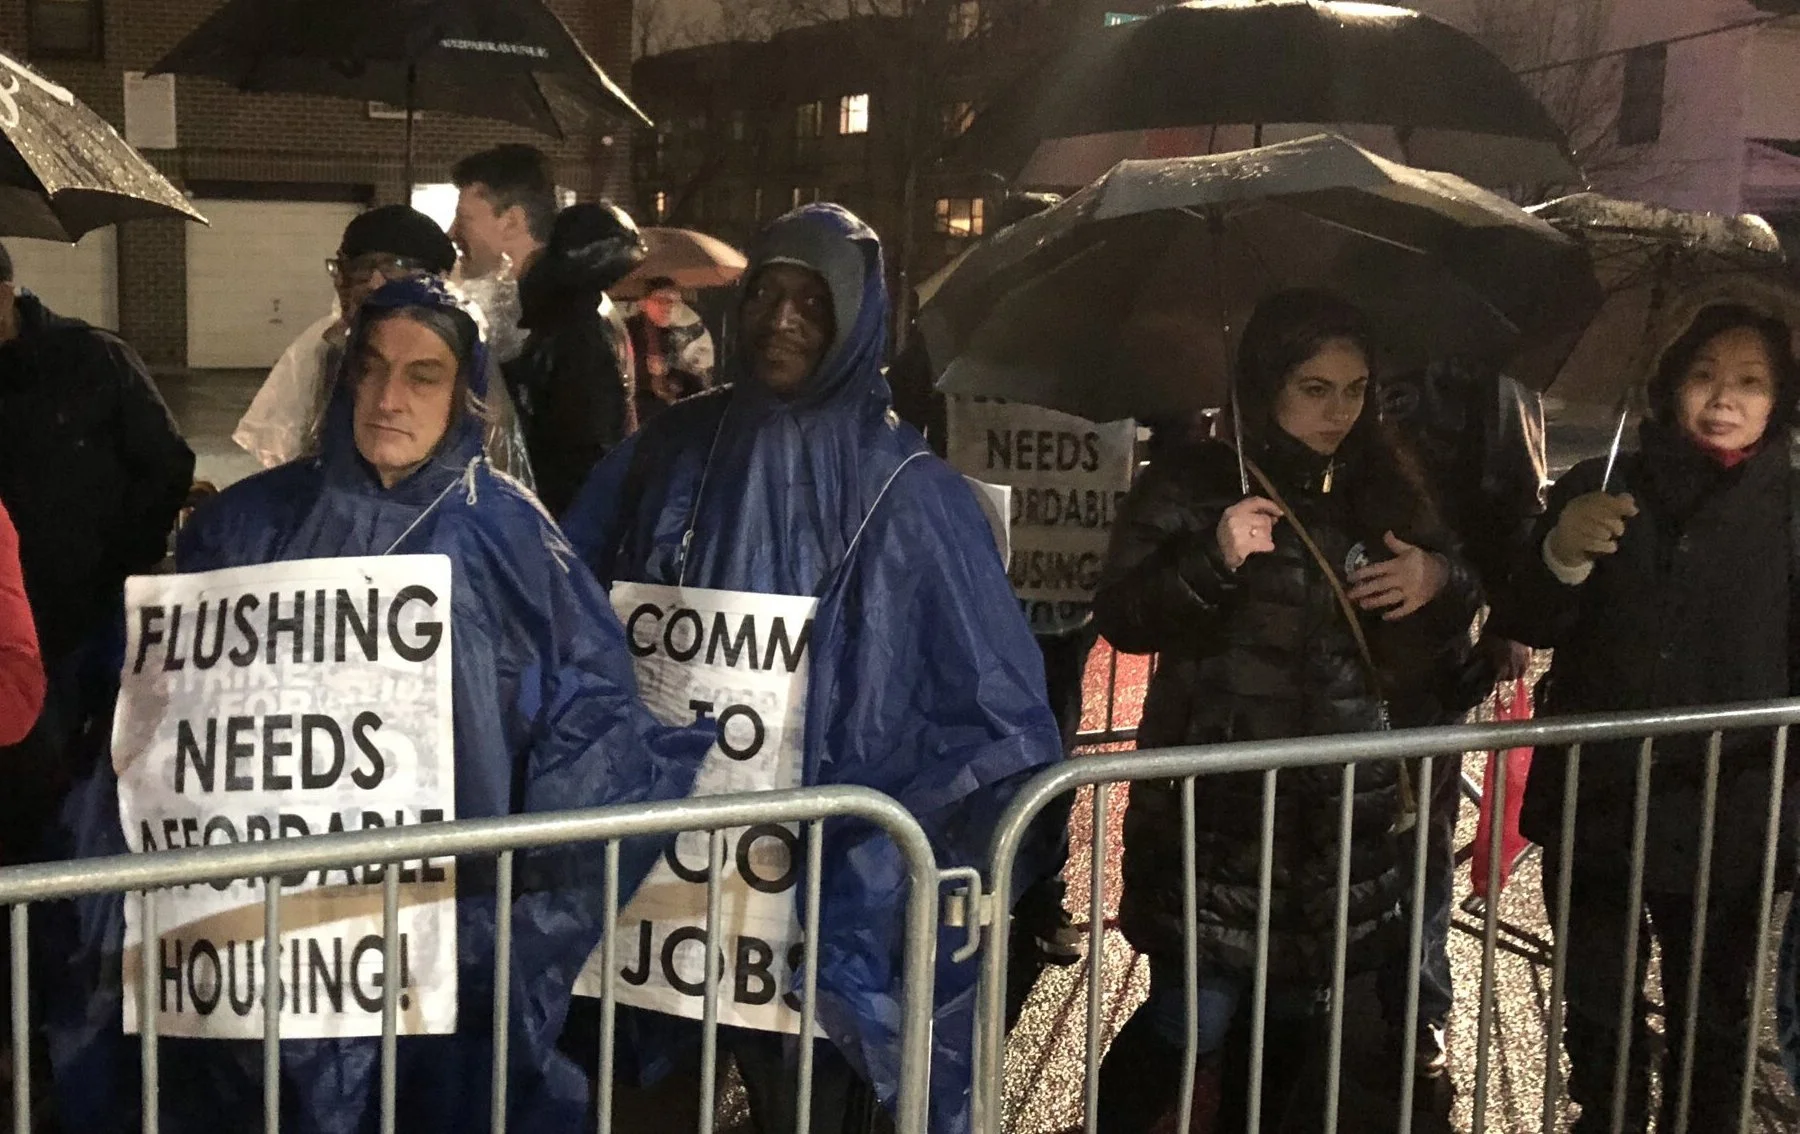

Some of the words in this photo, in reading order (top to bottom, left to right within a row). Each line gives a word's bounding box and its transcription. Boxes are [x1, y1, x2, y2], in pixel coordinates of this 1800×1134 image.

[986, 428, 1100, 474] NEEDS
[132, 585, 443, 674] FLUSHING
[174, 711, 385, 793] NEEDS
